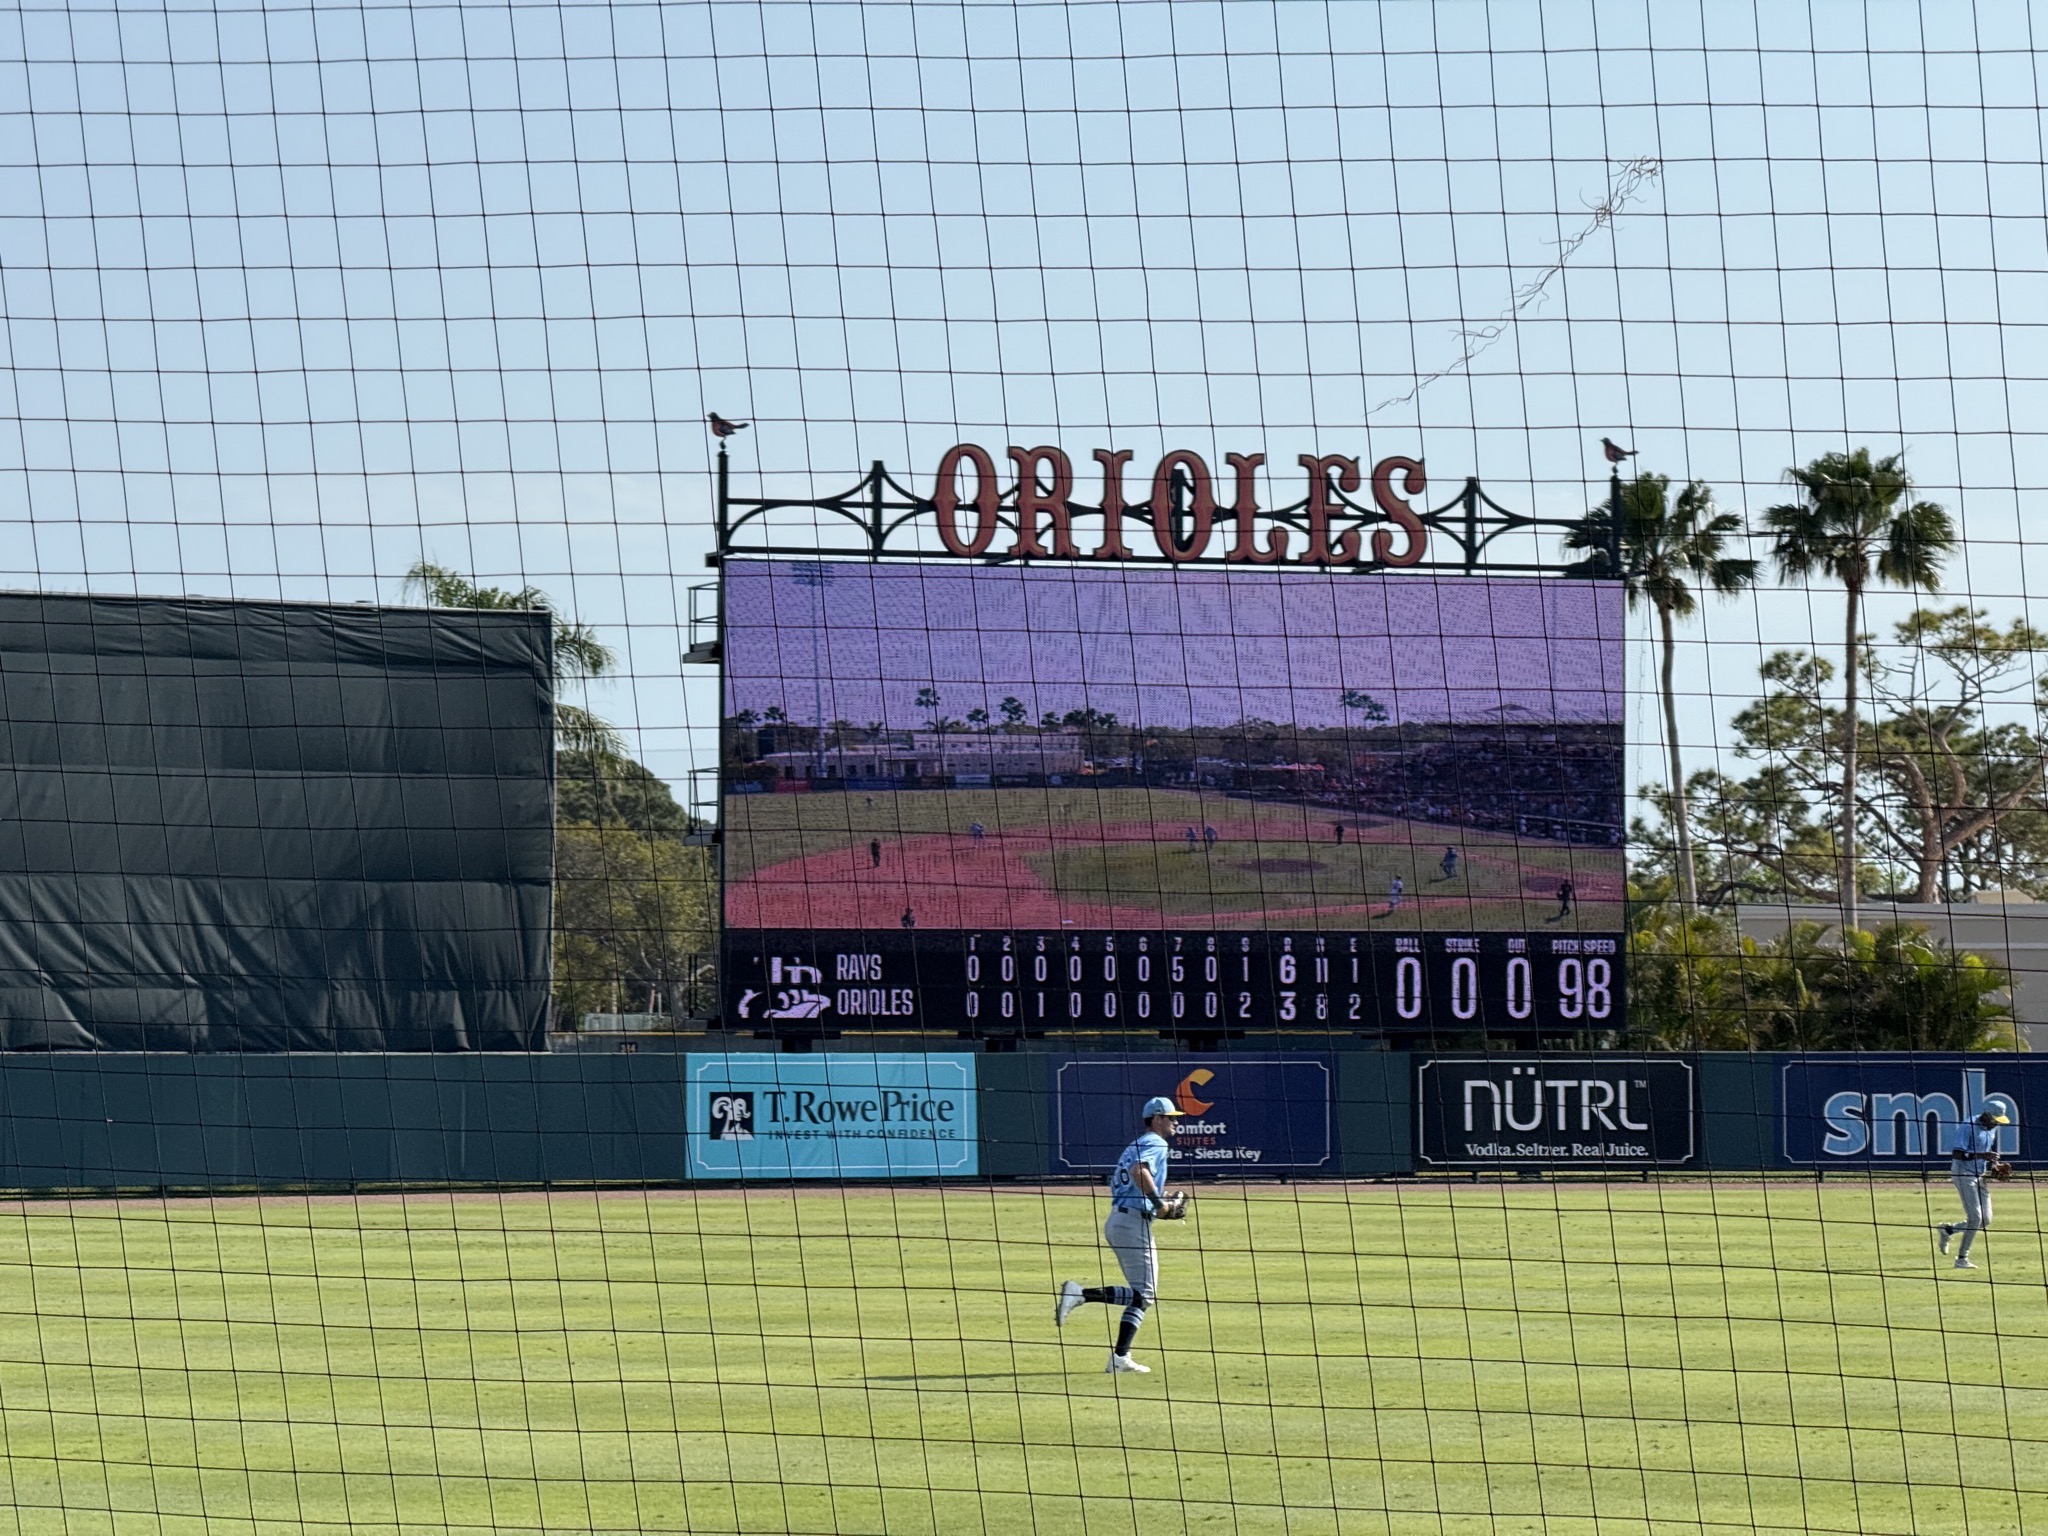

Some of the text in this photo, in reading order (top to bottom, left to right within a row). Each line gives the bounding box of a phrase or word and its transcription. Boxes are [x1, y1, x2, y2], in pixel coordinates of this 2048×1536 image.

[934, 443, 1427, 566] ORIOLES
[1003, 937, 1011, 951] 2
[1036, 937, 1045, 951] 3
[1071, 937, 1080, 951] 4
[1105, 937, 1113, 951] 5
[1139, 937, 1147, 951] 6
[1174, 937, 1182, 951] 7
[1395, 938, 1421, 954] BALL
[1445, 938, 1480, 954] STRIKE
[1507, 938, 1526, 954] OUT
[1552, 939, 1616, 955] PITCH SPEED
[836, 954, 1358, 984] RAYS 0 0 0 0 0 0 5 0 1 6 11 1
[1397, 957, 1421, 1018] 0
[1452, 957, 1476, 1019] 0
[1507, 957, 1531, 1018] 0
[1559, 958, 1611, 1019] 98
[837, 989, 1360, 1020] ORIOLES 0 0 1 0 0 0 0 0 2 3 8 2
[1823, 1068, 2020, 1155] smh
[769, 1128, 956, 1140] INVEST WITH CONFIDENCE
[1173, 1120, 1226, 1135] omfort
[1176, 1136, 1216, 1146] SUITES
[1195, 1147, 1233, 1160] Siesta
[1236, 1147, 1262, 1163] Key
[1465, 1143, 1649, 1157] Vodka. Seltzer. Real Juice.
